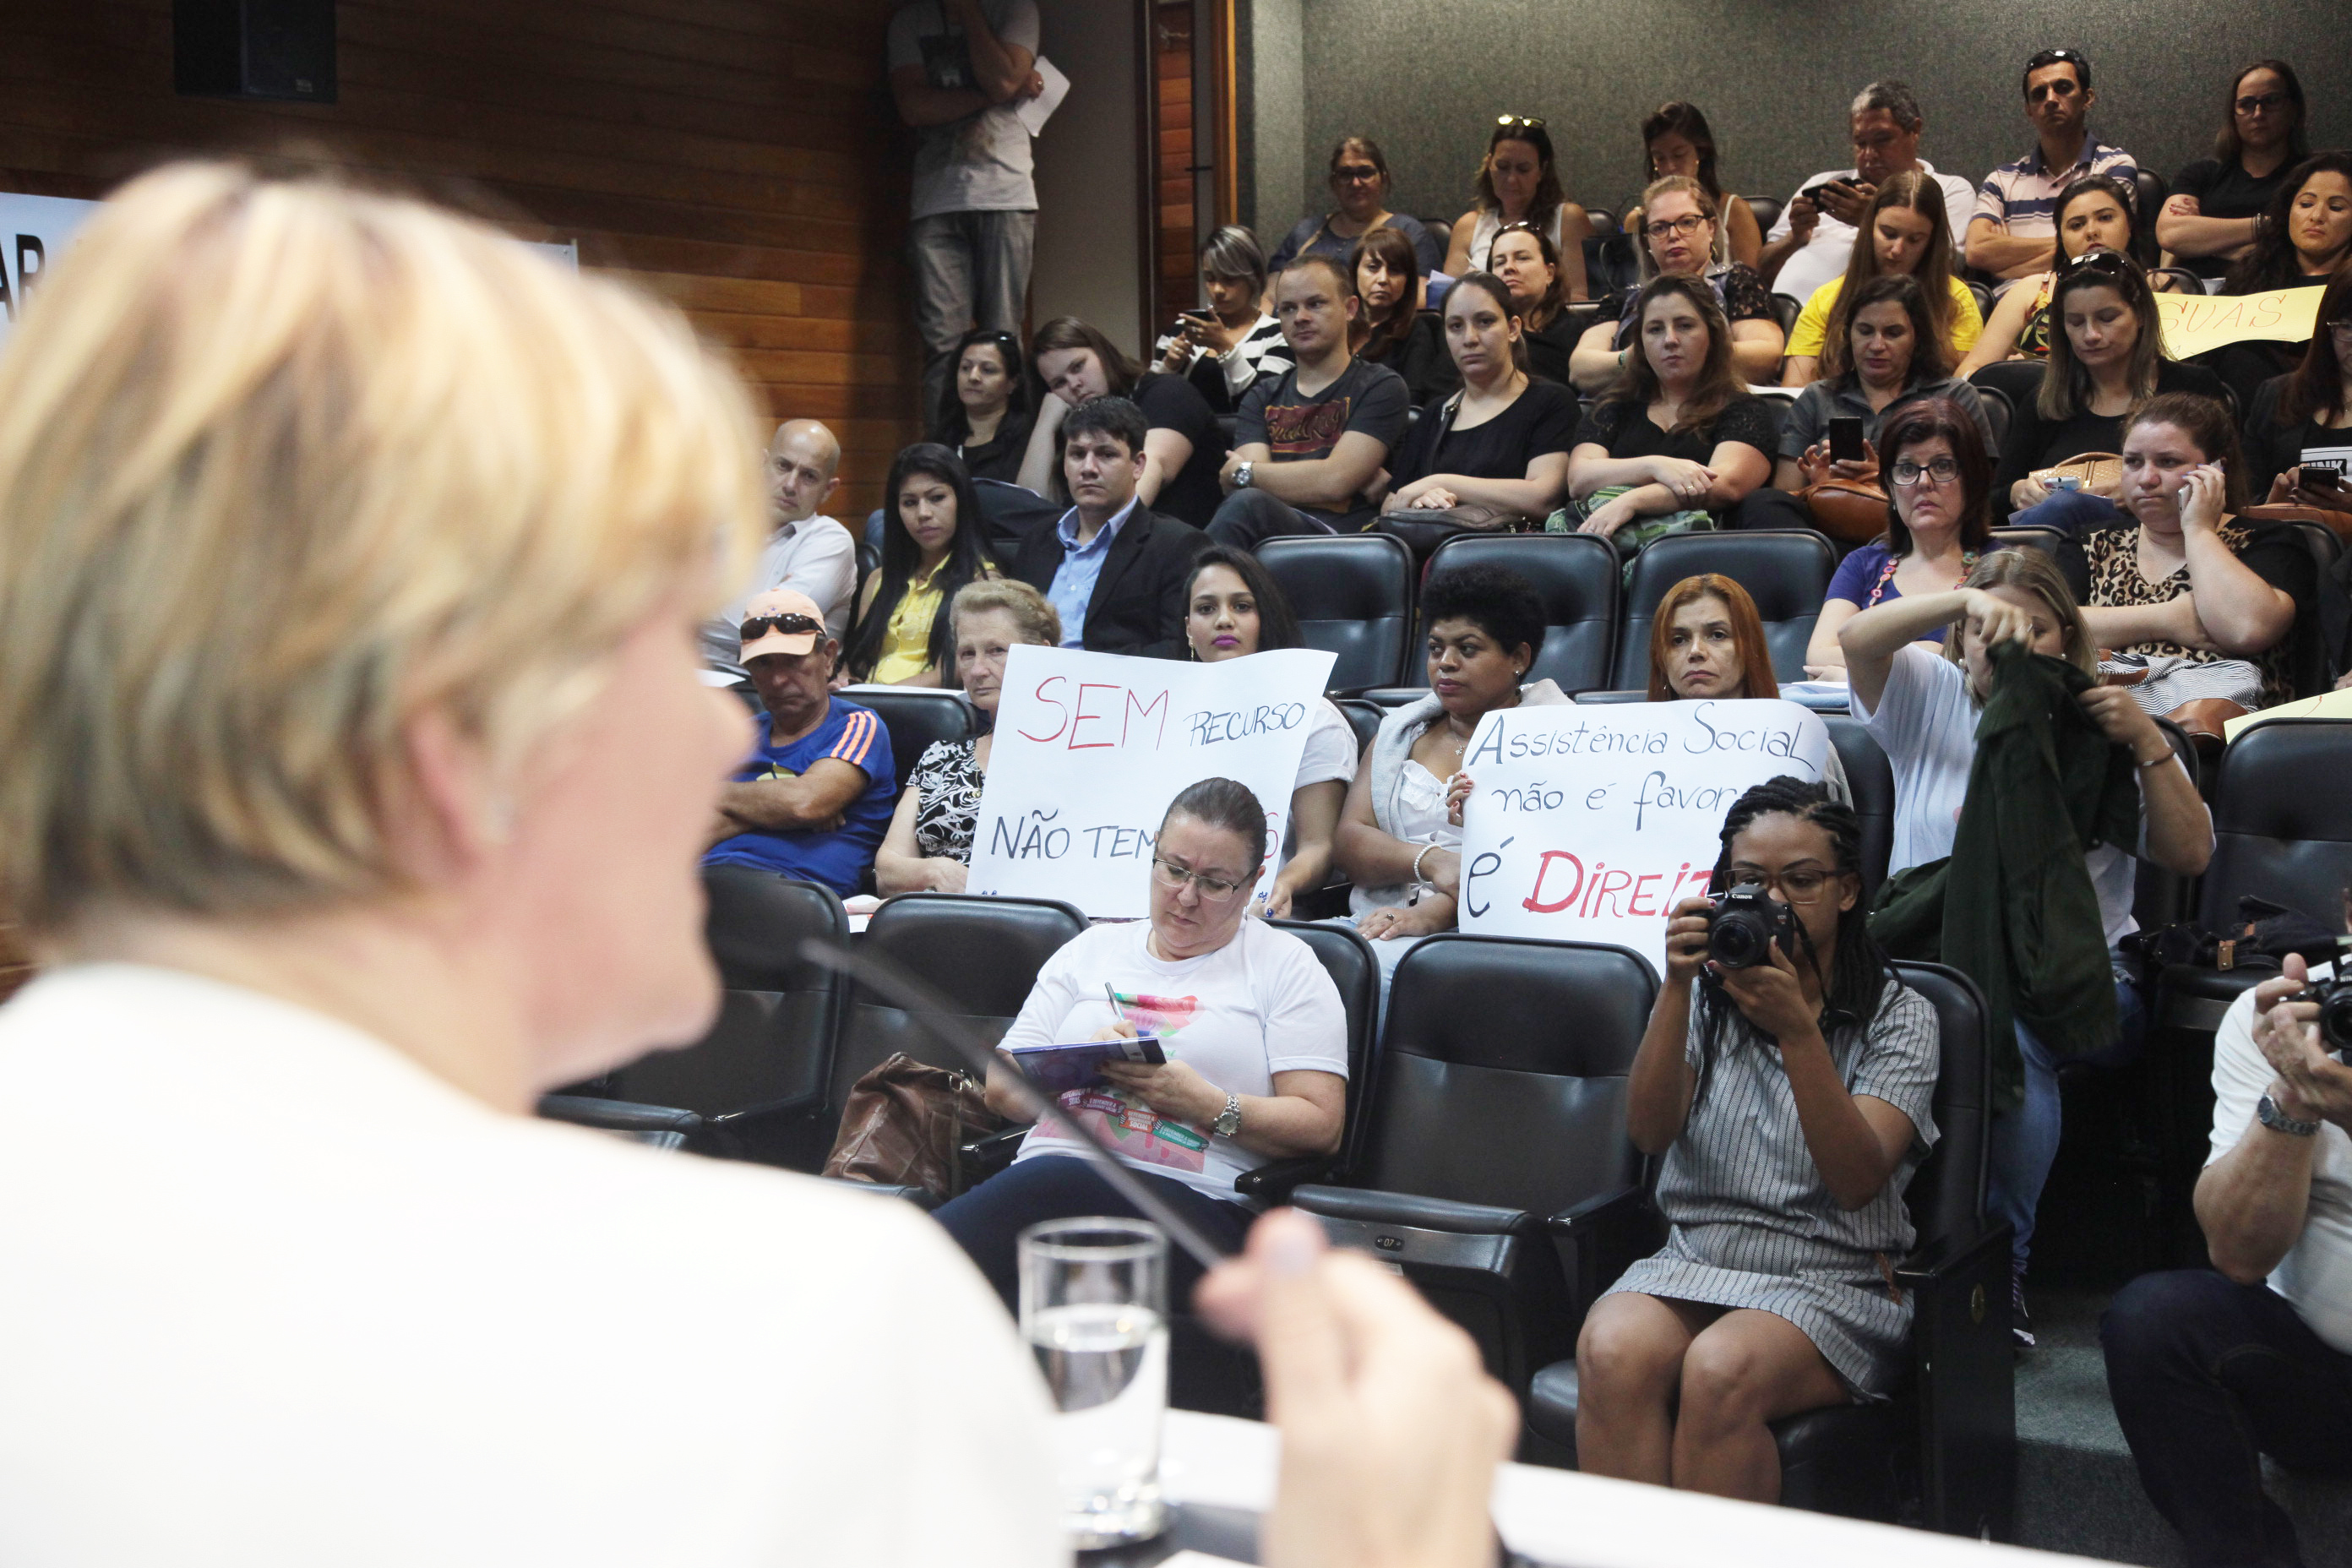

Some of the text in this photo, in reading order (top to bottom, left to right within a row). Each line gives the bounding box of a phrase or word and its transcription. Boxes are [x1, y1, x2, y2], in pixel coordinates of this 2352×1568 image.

[2157, 294, 2287, 333] SUAS
[1017, 676, 1306, 751] SEM RECURSO
[1468, 701, 1816, 771] Assistência Social
[1491, 770, 1737, 831] não é favor
[990, 808, 1156, 860] NÃO TEM
[1129, 1121, 1148, 1130] SOCIAL
[1384, 1238, 1394, 1247] 07
